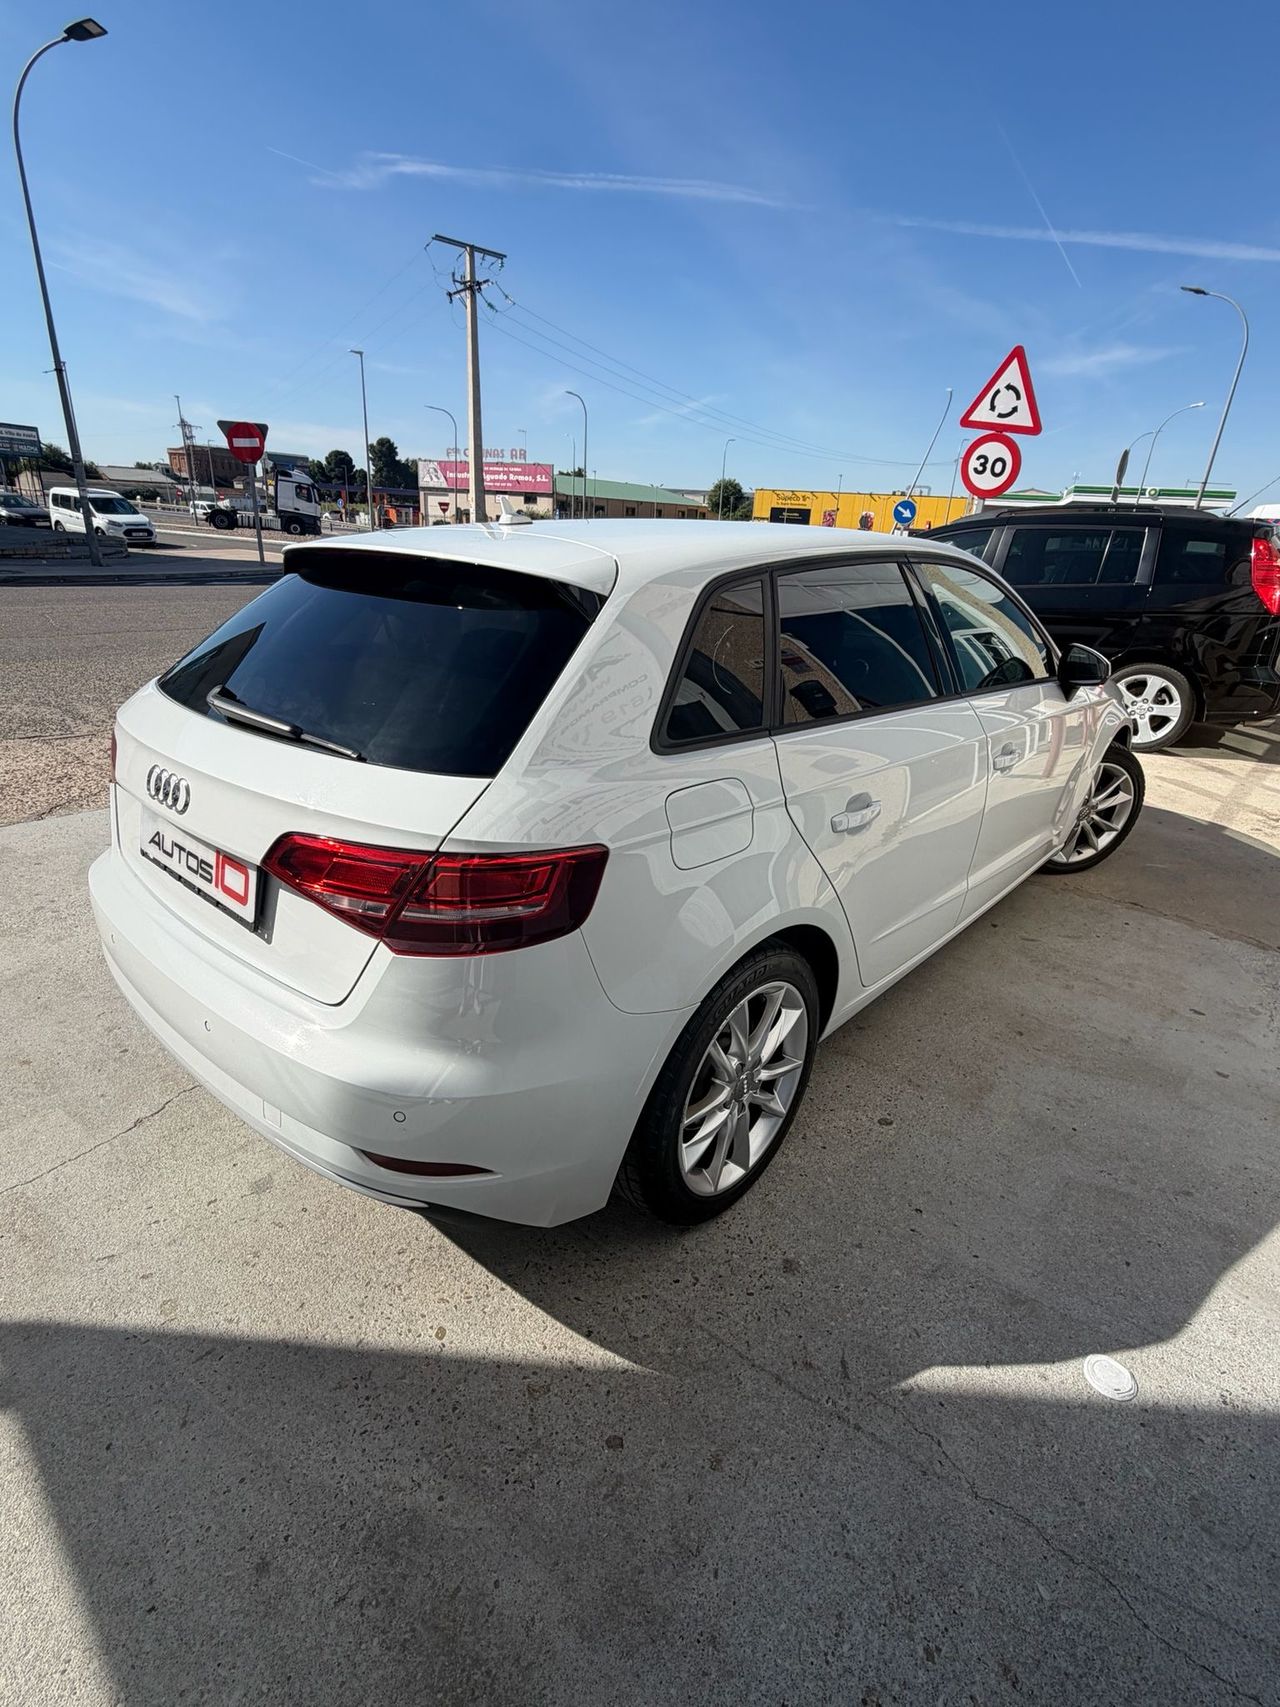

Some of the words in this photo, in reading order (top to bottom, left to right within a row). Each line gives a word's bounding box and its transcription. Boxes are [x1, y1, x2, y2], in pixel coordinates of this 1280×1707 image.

[463, 447, 505, 459] CNAS
[510, 448, 527, 461] AR
[973, 454, 1007, 478] 30
